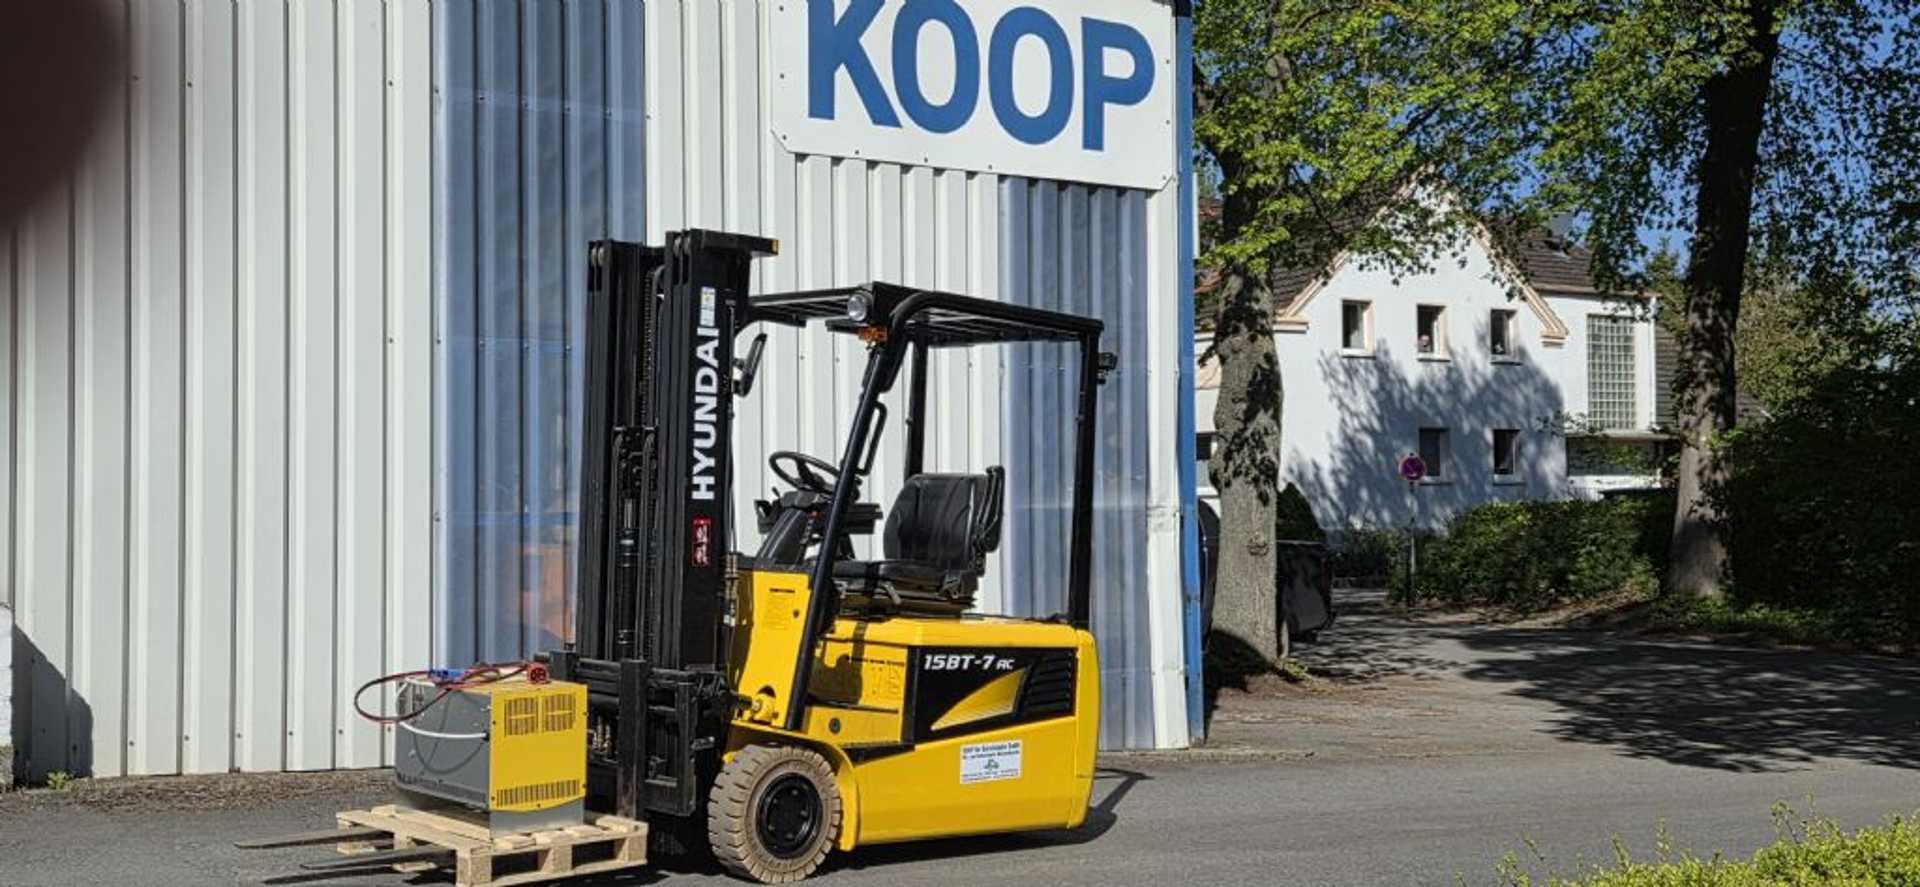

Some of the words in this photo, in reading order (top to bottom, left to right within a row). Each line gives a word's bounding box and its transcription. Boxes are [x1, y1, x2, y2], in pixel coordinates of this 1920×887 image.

[808, 0, 1155, 151] KOOP
[692, 327, 719, 500] HYUNDAI
[924, 654, 995, 670] 15BT-7
